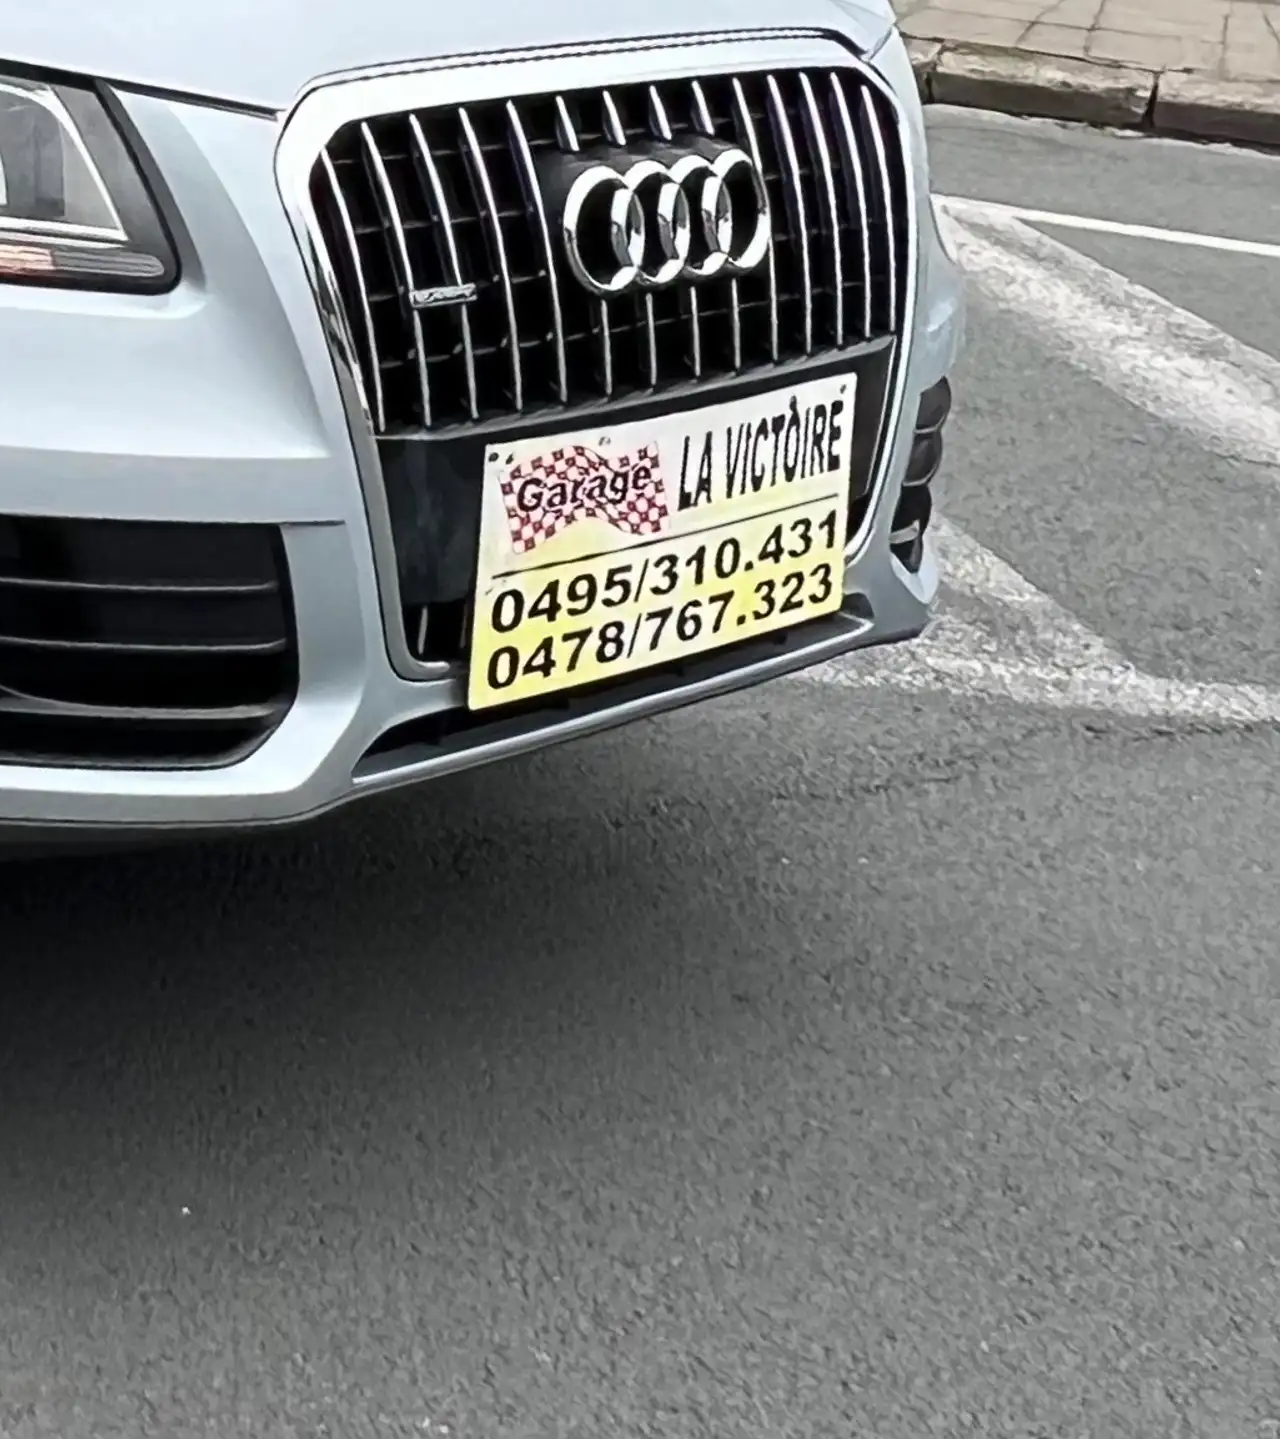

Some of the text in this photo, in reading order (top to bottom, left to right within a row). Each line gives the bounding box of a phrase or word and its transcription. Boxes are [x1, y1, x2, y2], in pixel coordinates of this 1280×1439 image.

[517, 464, 652, 511] Garage
[678, 400, 843, 511] LA VICTOIRE
[486, 563, 834, 690] 0478/767.323
[491, 509, 838, 633] 0495/310.431
